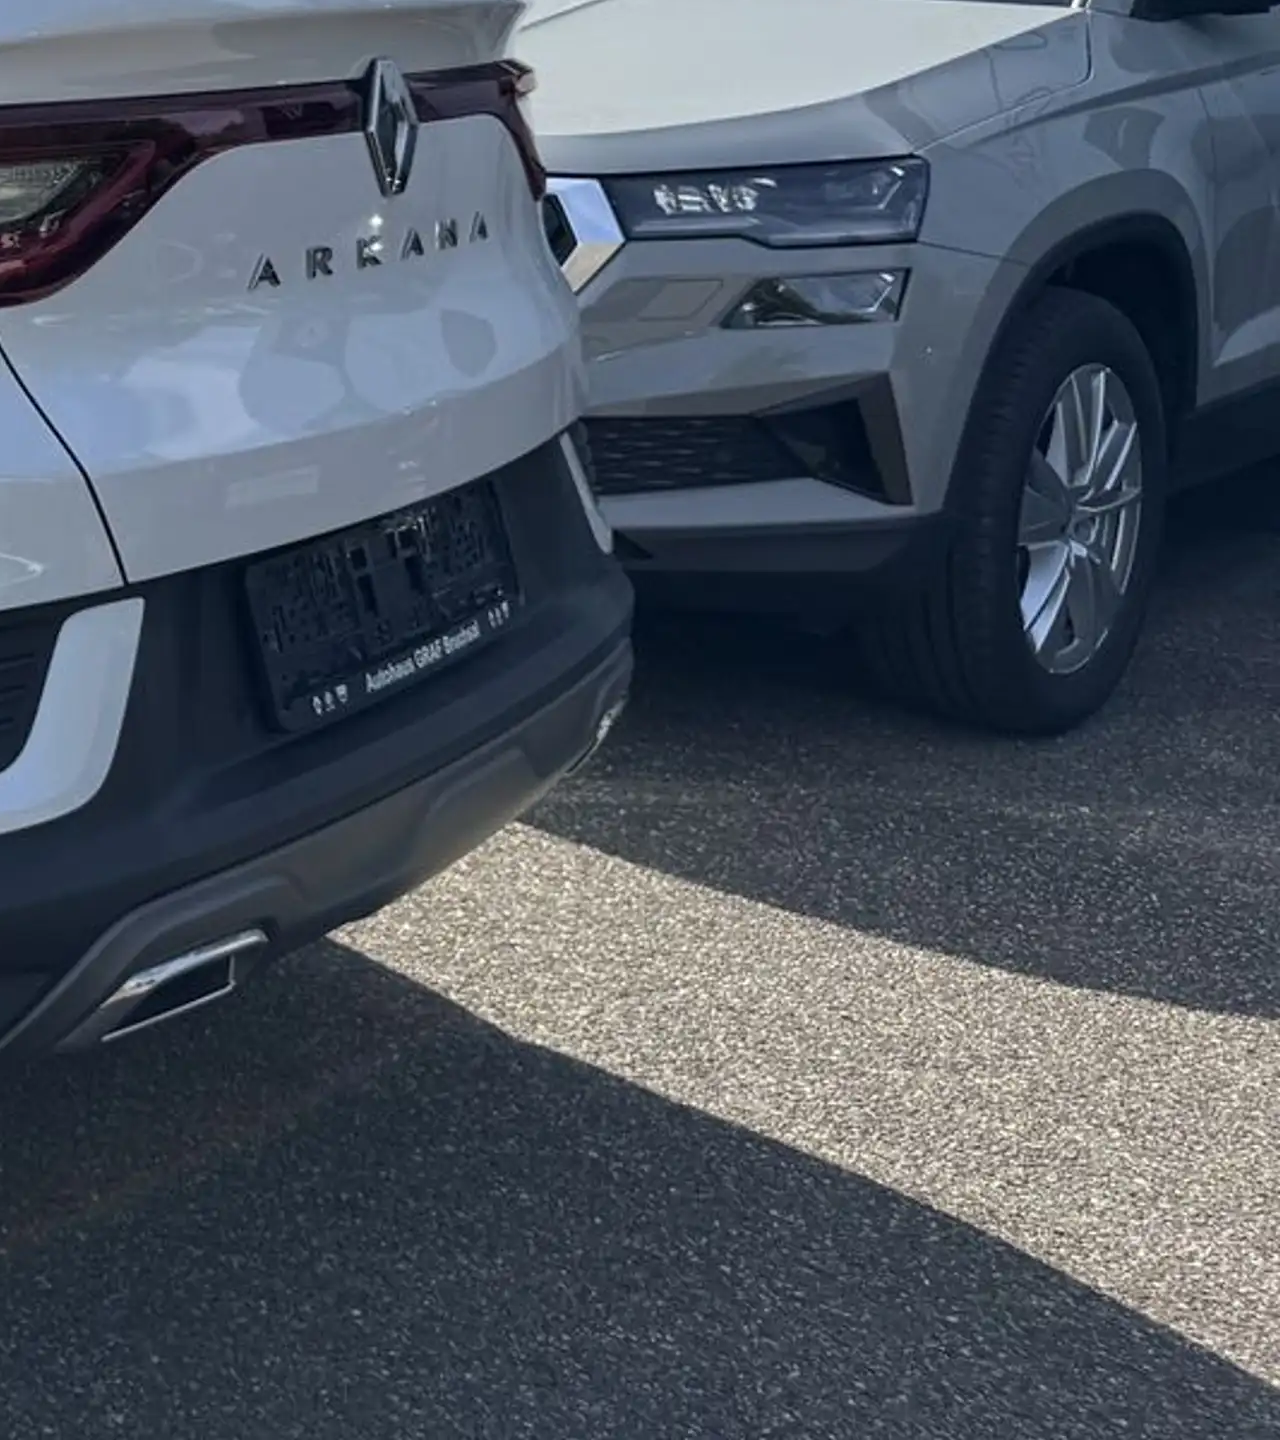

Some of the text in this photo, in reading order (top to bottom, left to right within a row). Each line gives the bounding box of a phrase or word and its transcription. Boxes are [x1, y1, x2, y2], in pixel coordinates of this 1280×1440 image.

[247, 211, 490, 291] ARKANA
[366, 657, 415, 692] Autohaus
[414, 638, 443, 668] GRAF
